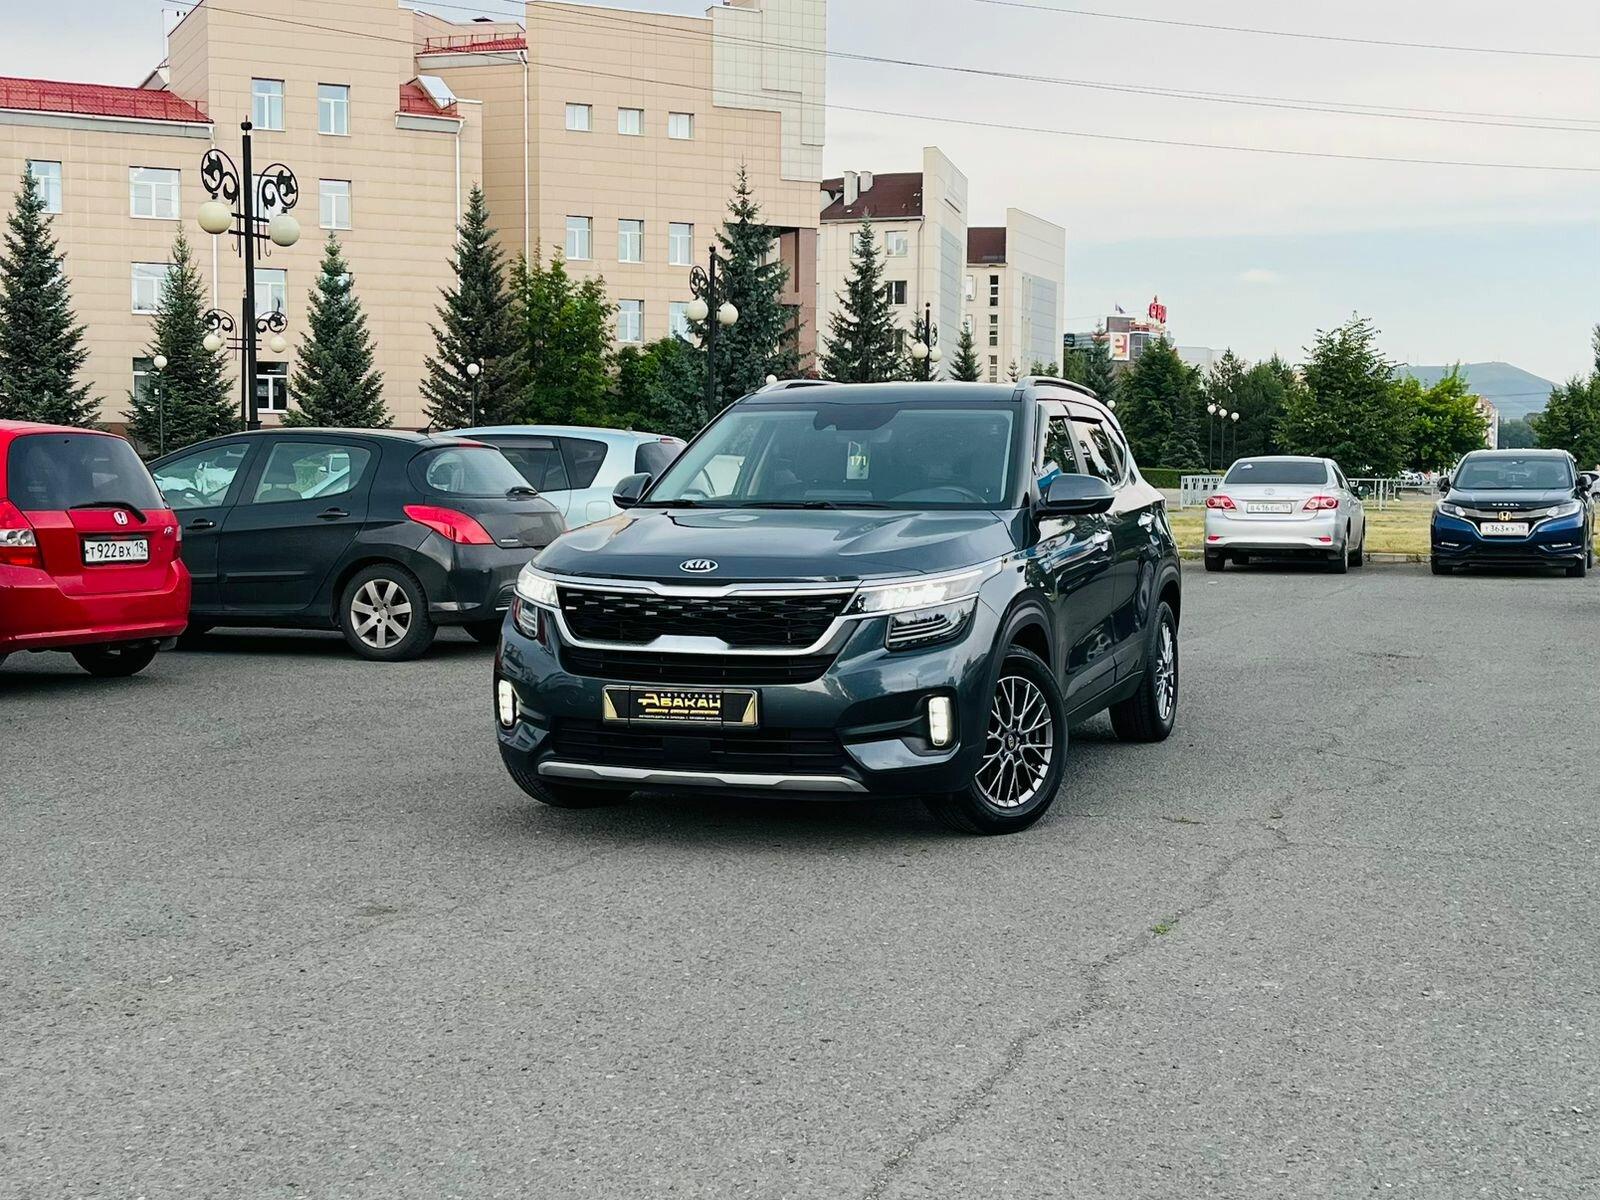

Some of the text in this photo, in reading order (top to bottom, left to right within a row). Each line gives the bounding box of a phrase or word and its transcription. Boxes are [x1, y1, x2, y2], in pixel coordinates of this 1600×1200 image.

[850, 455, 867, 466] 171
[90, 541, 144, 558] Т922ВХ 19
[685, 560, 711, 569] KIA
[638, 693, 721, 709] АБАКАН
